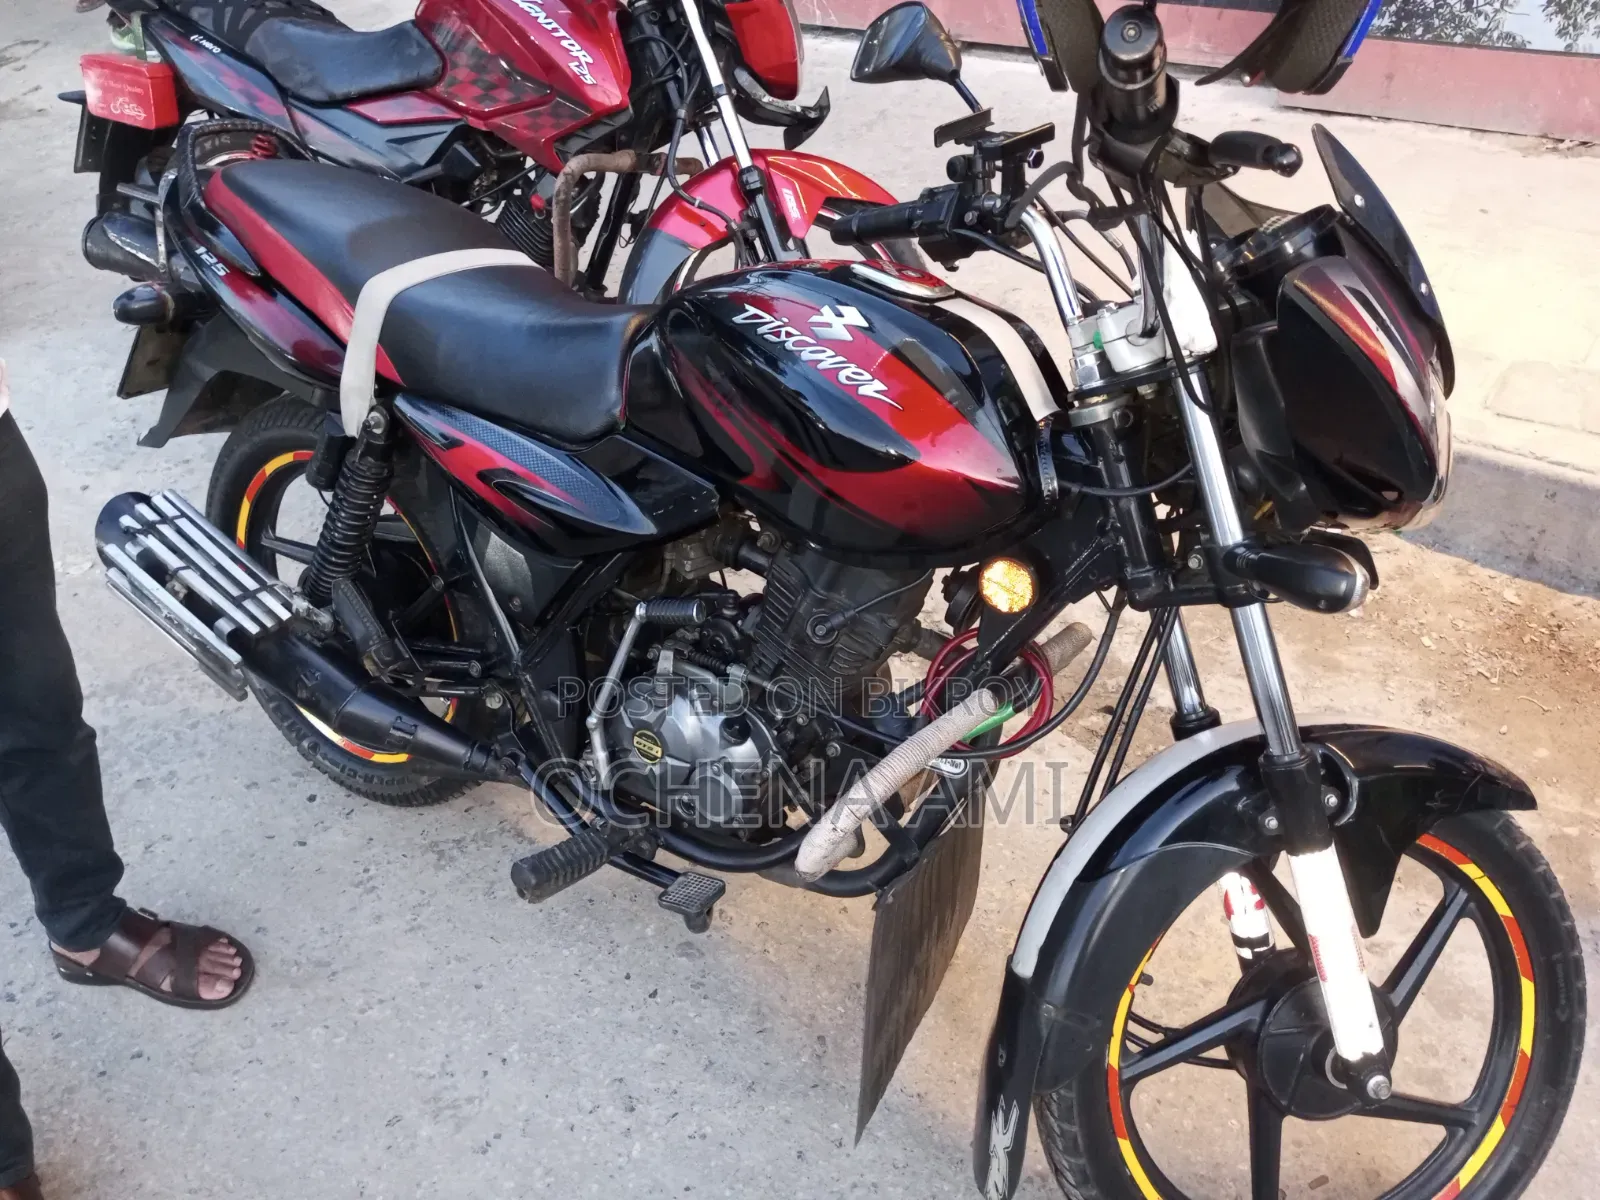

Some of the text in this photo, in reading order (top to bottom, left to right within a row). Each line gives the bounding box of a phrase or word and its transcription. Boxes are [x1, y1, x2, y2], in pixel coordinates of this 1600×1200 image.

[567, 61, 597, 84] 125
[194, 246, 230, 276] 125
[732, 303, 903, 410] Discover
